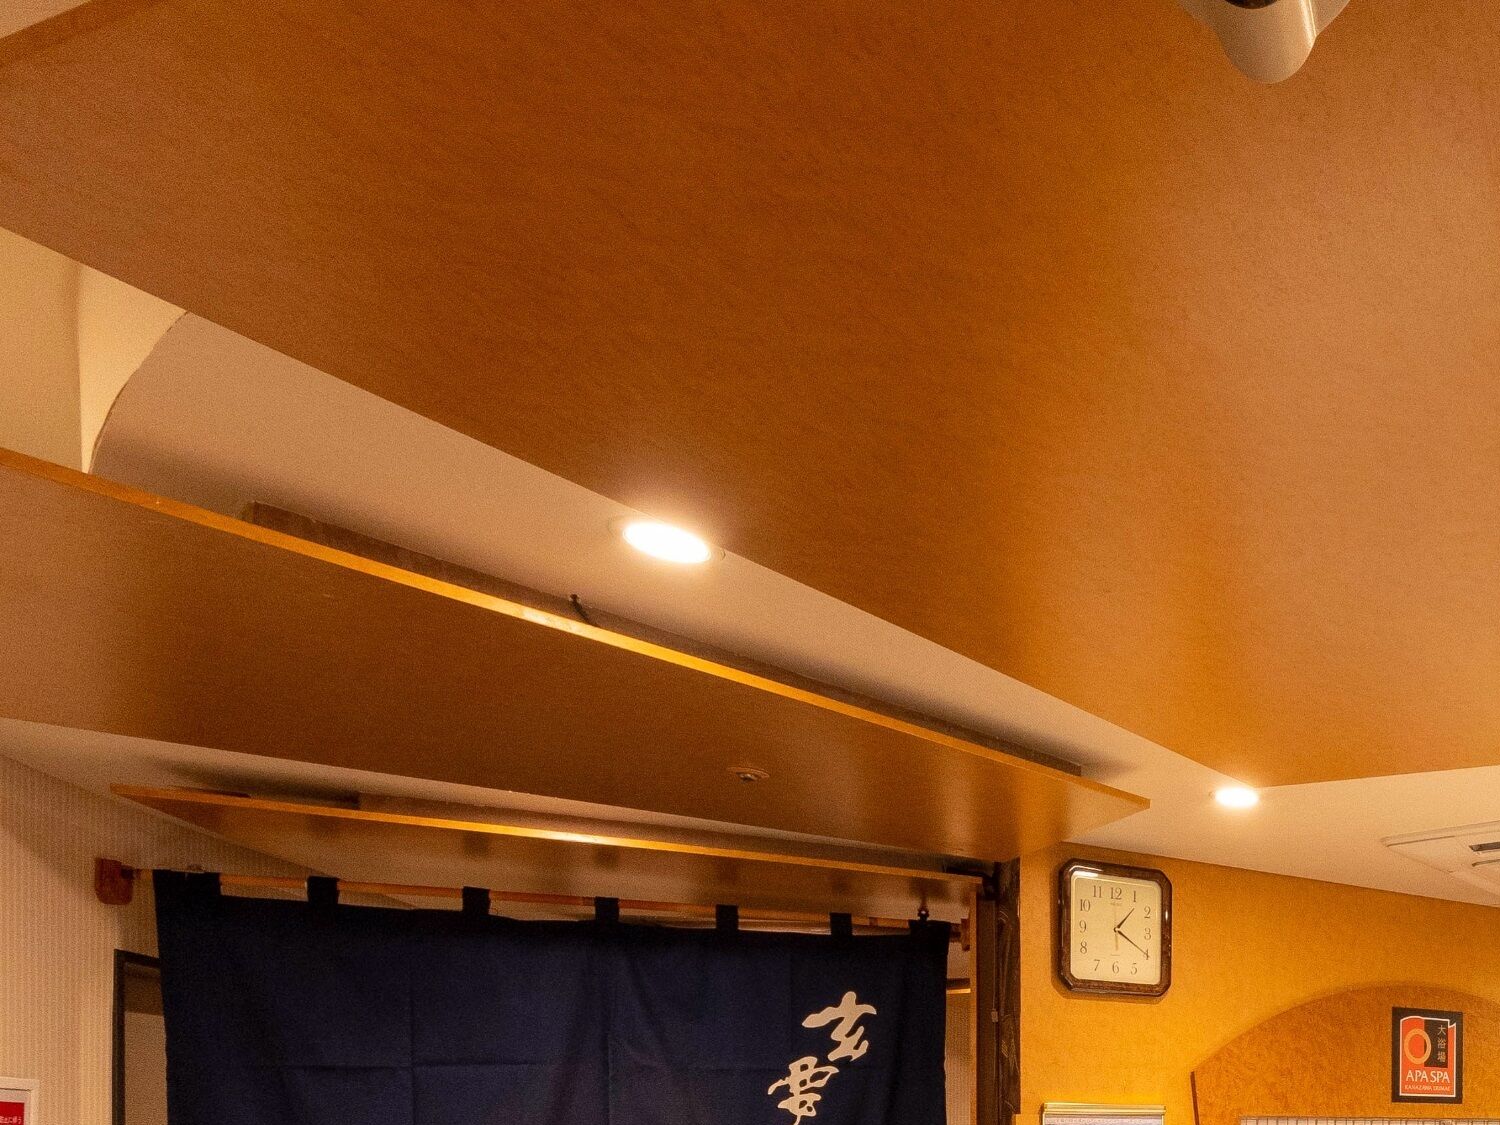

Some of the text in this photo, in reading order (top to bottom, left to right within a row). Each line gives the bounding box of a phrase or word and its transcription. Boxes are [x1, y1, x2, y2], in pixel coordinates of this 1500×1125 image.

[1093, 885, 1102, 898] 11
[1110, 887, 1122, 900] 12
[1080, 898, 1091, 912] 10
[1144, 906, 1151, 919] 2
[1080, 920, 1087, 933] 9
[1144, 928, 1152, 941] 3
[1080, 941, 1088, 954] 8
[1144, 949, 1150, 960] 4
[1093, 959, 1100, 971] 7
[1112, 961, 1120, 974] 6
[1130, 963, 1138, 975] 5
[1437, 1024, 1447, 1063] 大浴場
[1406, 1069, 1450, 1083] APA SPA
